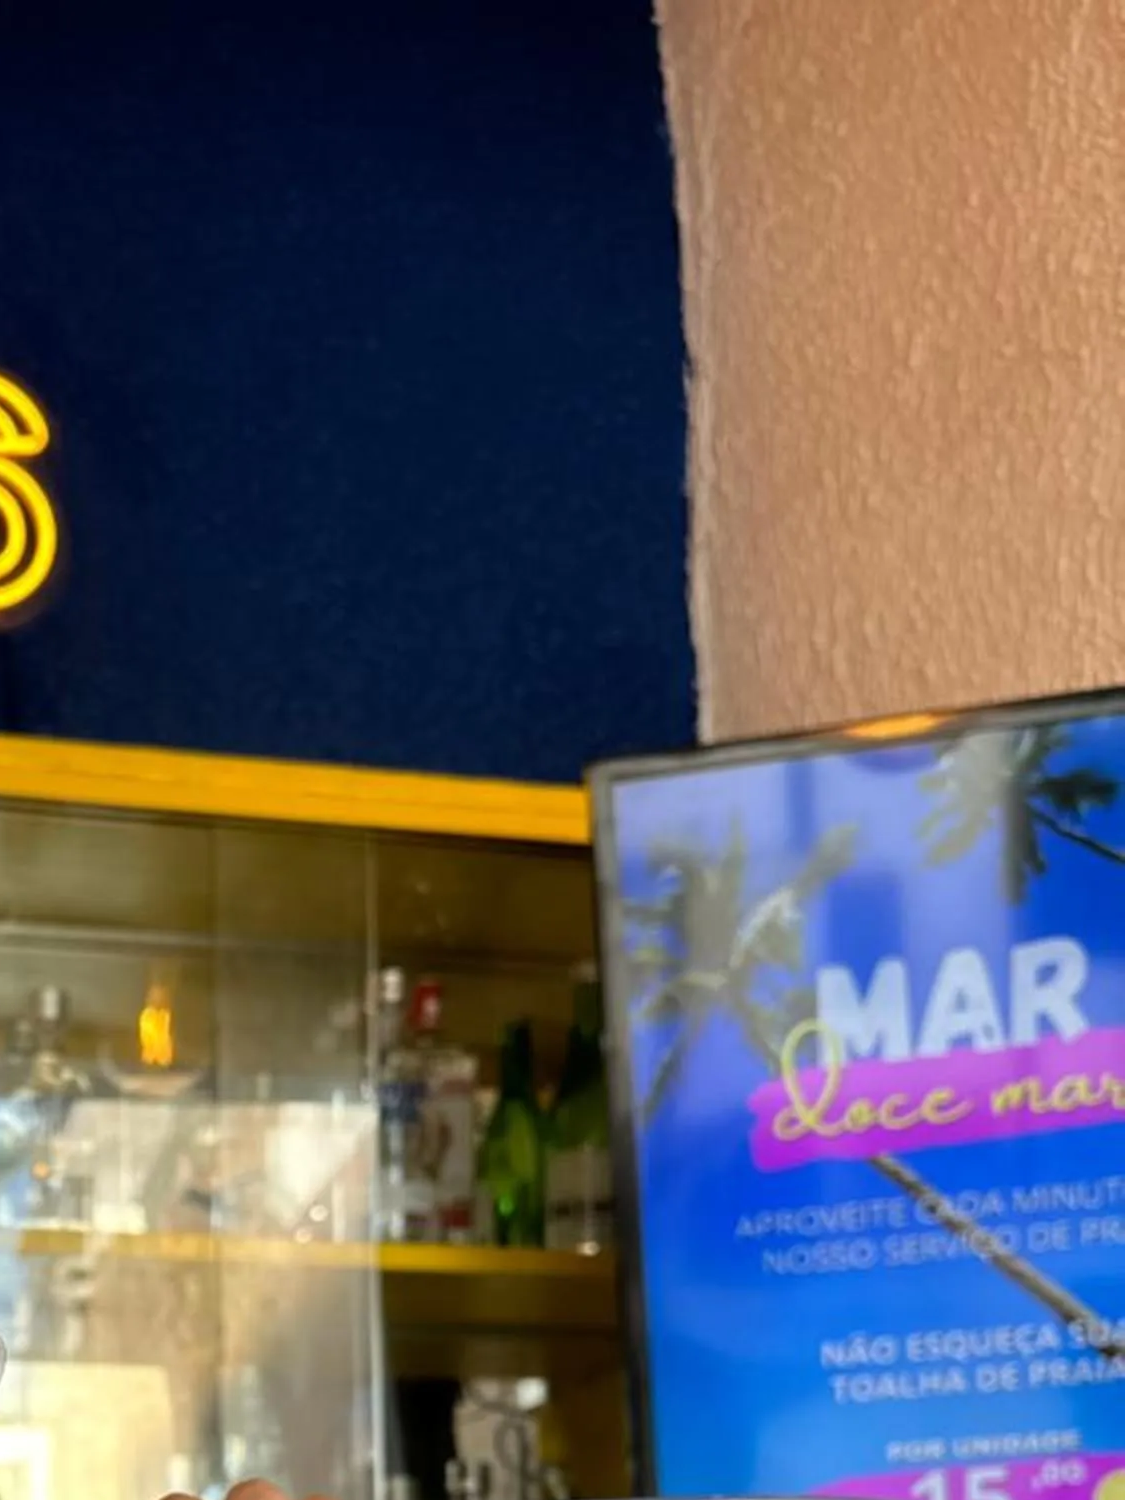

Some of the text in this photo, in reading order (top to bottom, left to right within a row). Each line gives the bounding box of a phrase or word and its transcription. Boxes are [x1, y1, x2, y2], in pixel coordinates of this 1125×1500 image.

[815, 935, 1090, 1071] MAR
[773, 1017, 973, 1142] doce
[735, 1196, 908, 1239] APROVEITE
[762, 1237, 876, 1275] NOSSO
[1027, 1217, 1071, 1254] DE
[820, 1330, 899, 1369] NÃO
[905, 1319, 1062, 1364] ESQUEÇA
[830, 1367, 968, 1404] TOALHA
[974, 1361, 1020, 1394] DE
[886, 1427, 1082, 1463] POR UNIDADE
